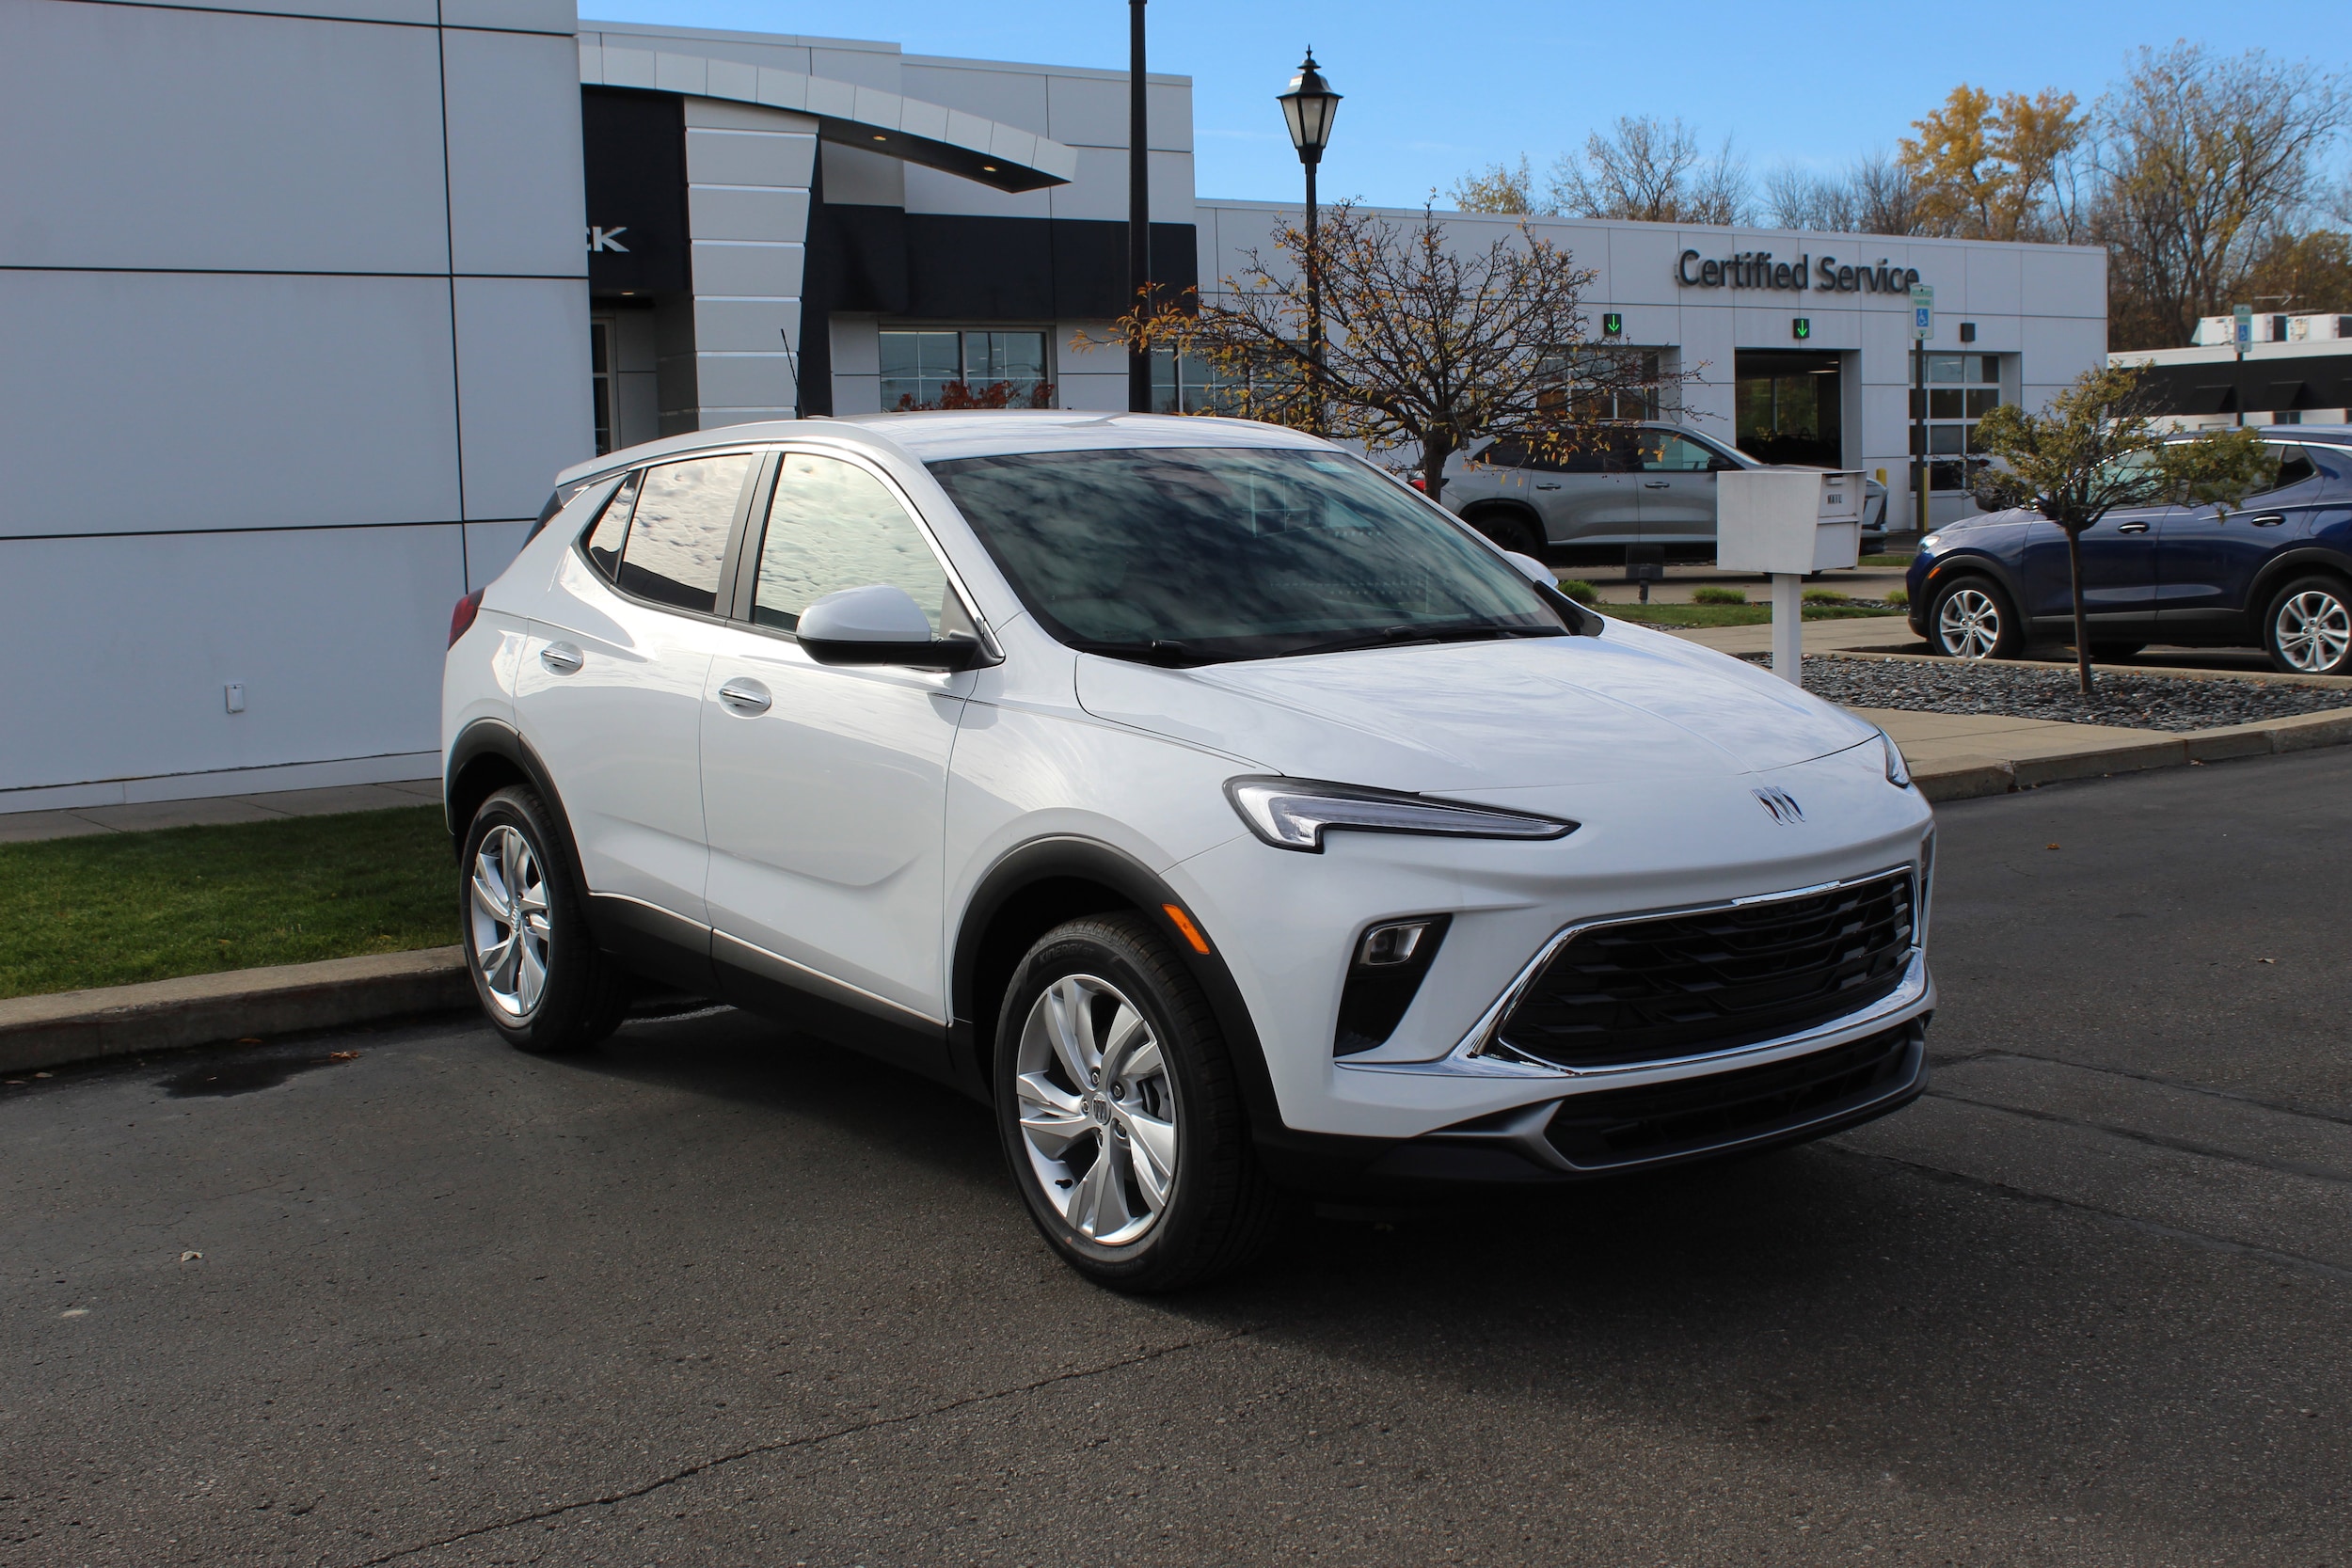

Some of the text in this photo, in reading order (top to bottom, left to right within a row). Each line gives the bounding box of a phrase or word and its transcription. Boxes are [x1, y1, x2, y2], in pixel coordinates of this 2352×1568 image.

[586, 226, 630, 252] K
[1676, 248, 1920, 293] Certified Service
[1827, 494, 1842, 505] MAIL
